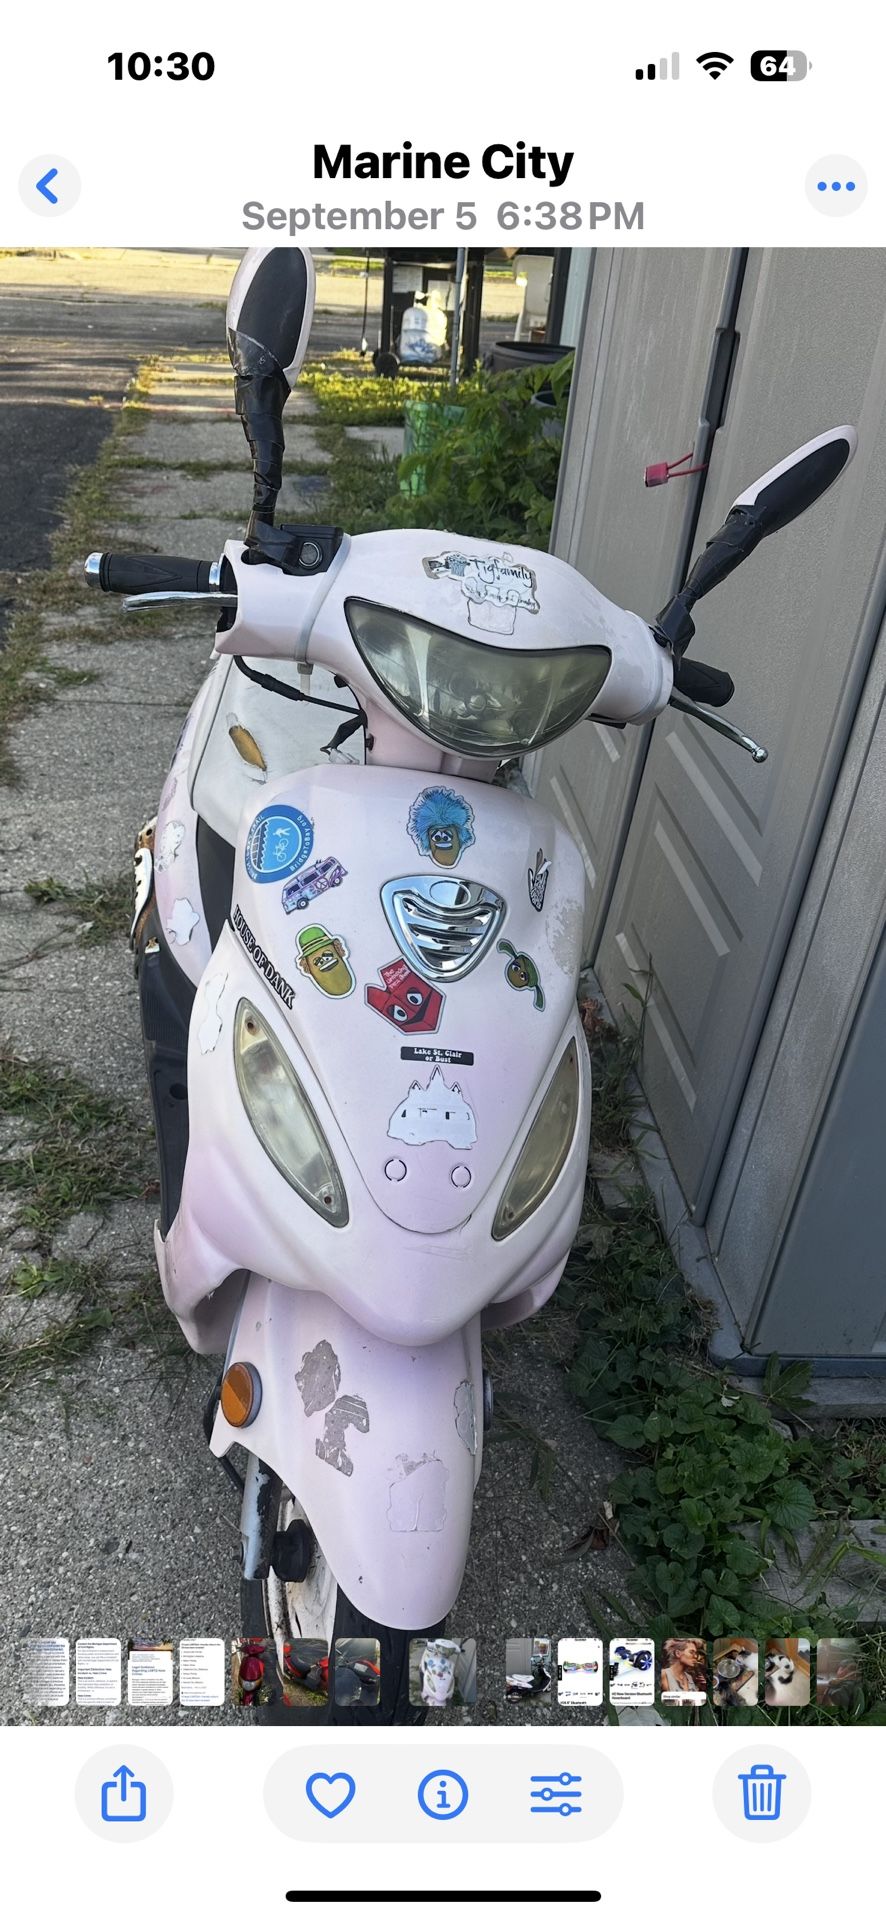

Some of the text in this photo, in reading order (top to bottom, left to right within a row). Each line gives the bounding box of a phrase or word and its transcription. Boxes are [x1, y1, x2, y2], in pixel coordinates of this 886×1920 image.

[233, 906, 255, 953] HOUSE
[252, 946, 266, 968] OF
[264, 962, 294, 1008] DANK
[414, 1047, 431, 1056] Lake
[445, 1050, 462, 1059] Clair
[435, 1055, 452, 1063] Bust
